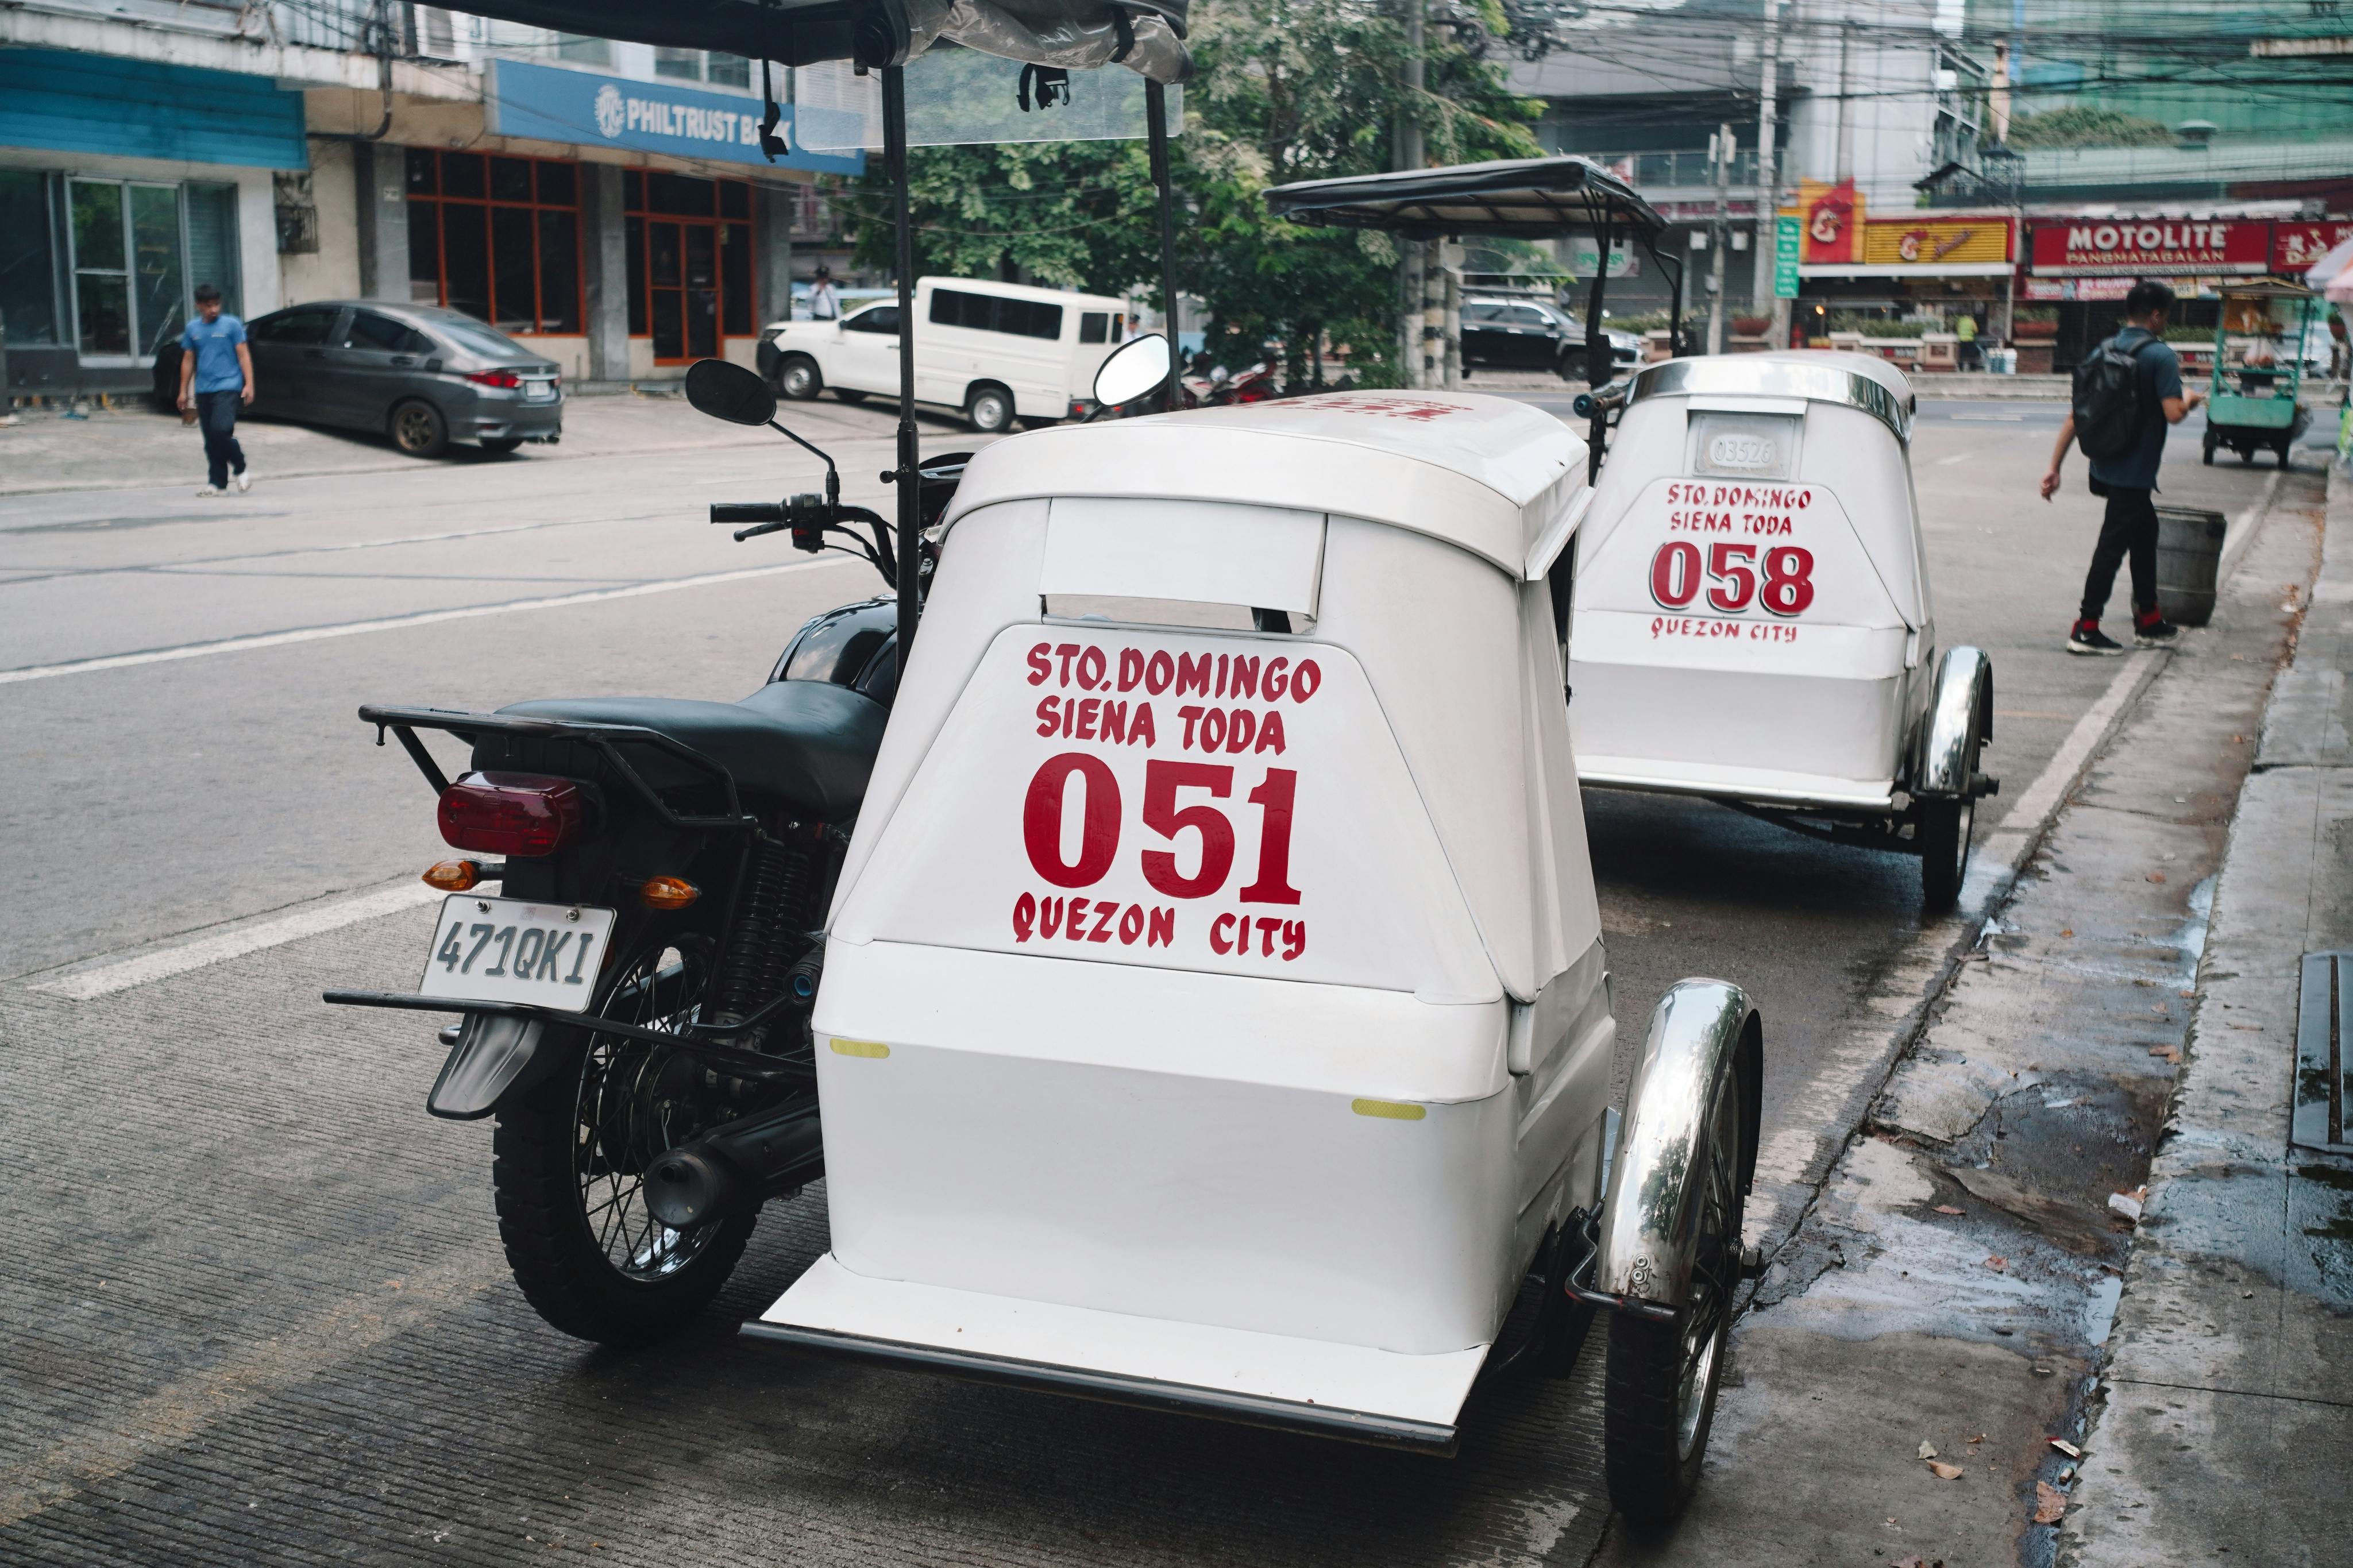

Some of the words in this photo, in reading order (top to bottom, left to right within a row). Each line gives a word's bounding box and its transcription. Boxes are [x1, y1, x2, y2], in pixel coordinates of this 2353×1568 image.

[627, 97, 738, 143] PHILTRUST
[739, 115, 793, 150] BAK
[2066, 249, 2225, 264] PANGMATAGALAN
[2068, 223, 2227, 250] MOTOLITE
[1714, 439, 1772, 464] 03526
[1667, 484, 1811, 509] STO.DOMINGO
[1670, 511, 1731, 533] SIENA
[1743, 513, 1792, 536] TODA
[1649, 541, 1815, 617] 058
[1651, 617, 1740, 640] QUEZON
[1750, 624, 1797, 643] CITY
[1027, 642, 1321, 704] STO.DOMINGO
[1036, 695, 1156, 748] SIENA
[1178, 705, 1286, 755] TODA
[1023, 752, 1302, 906] 051
[437, 921, 593, 984] 471QKI
[1012, 891, 1175, 948] QUEZON
[1209, 912, 1306, 961] CITY
